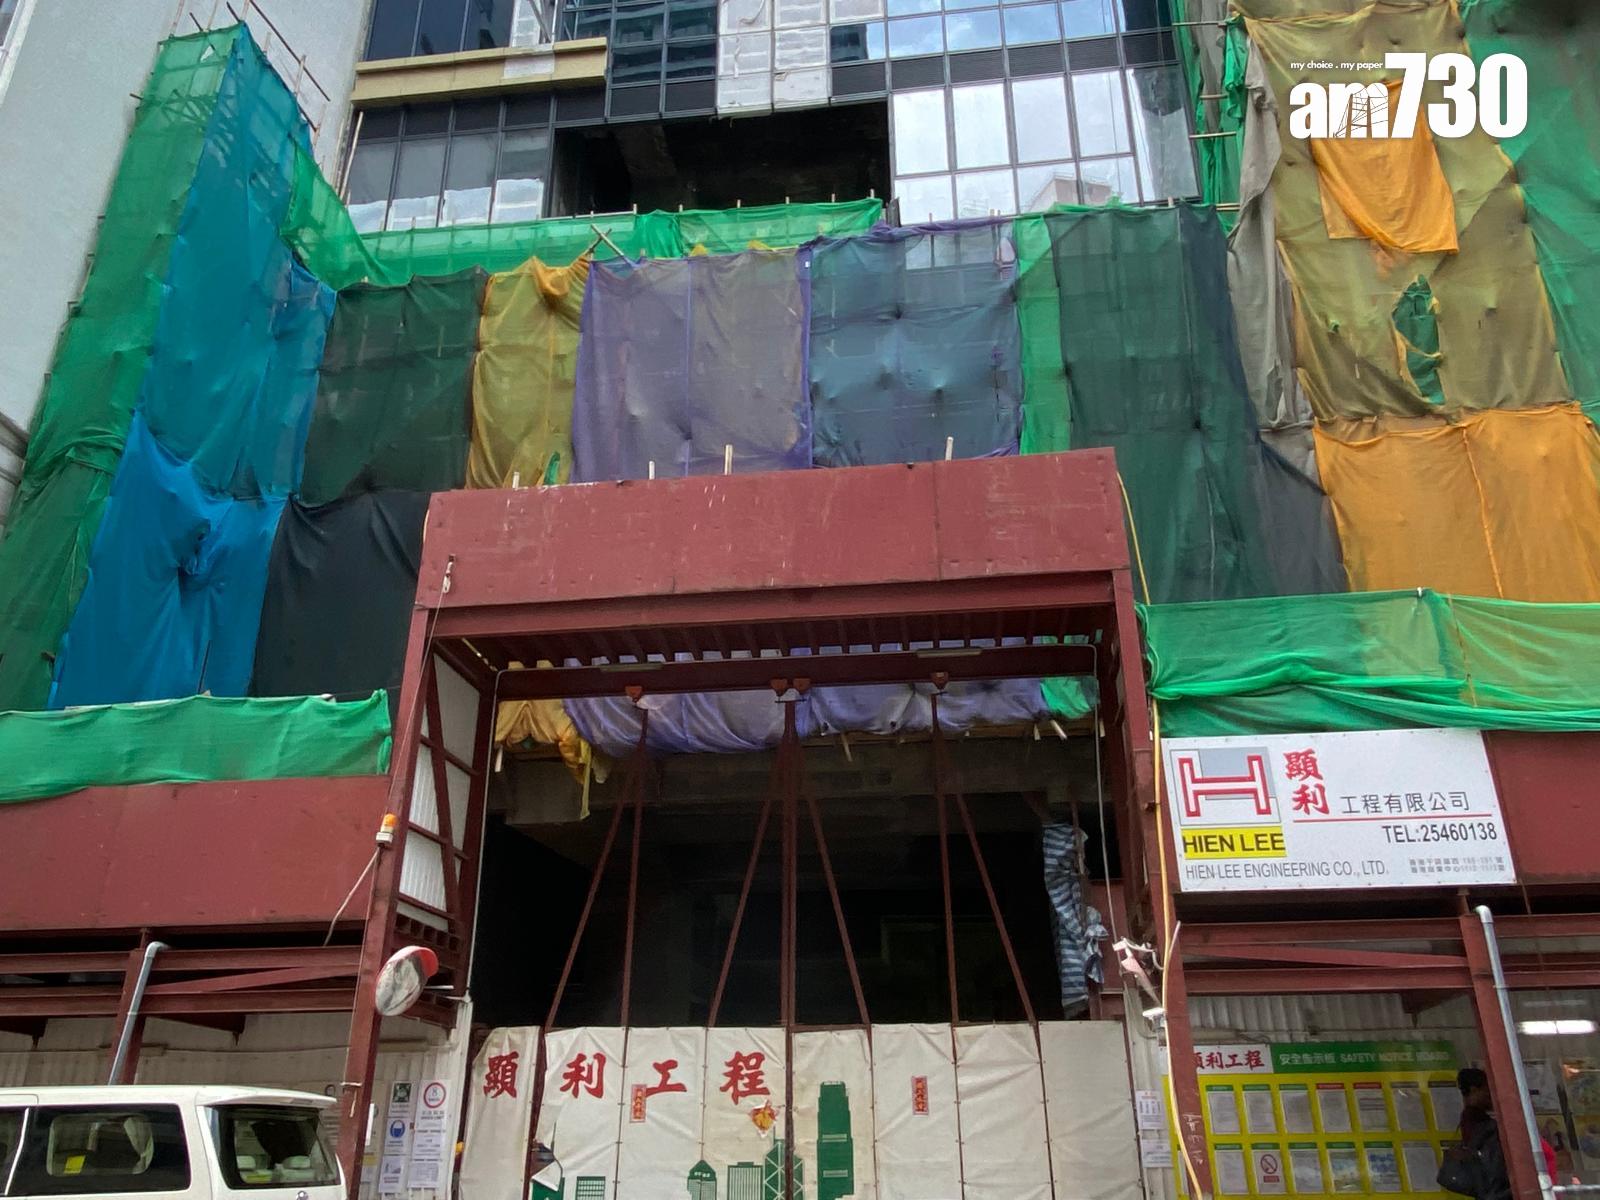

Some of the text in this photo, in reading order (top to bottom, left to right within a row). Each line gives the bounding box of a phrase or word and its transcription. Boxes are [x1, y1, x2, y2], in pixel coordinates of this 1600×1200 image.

[1340, 791, 1471, 816] 工程有限公司
[1182, 833, 1287, 854] HIEN LEE
[1382, 822, 1498, 844] TEL:25460138
[1244, 861, 1331, 879] ENGINEERING
[1339, 1051, 1377, 1064] SAFETY
